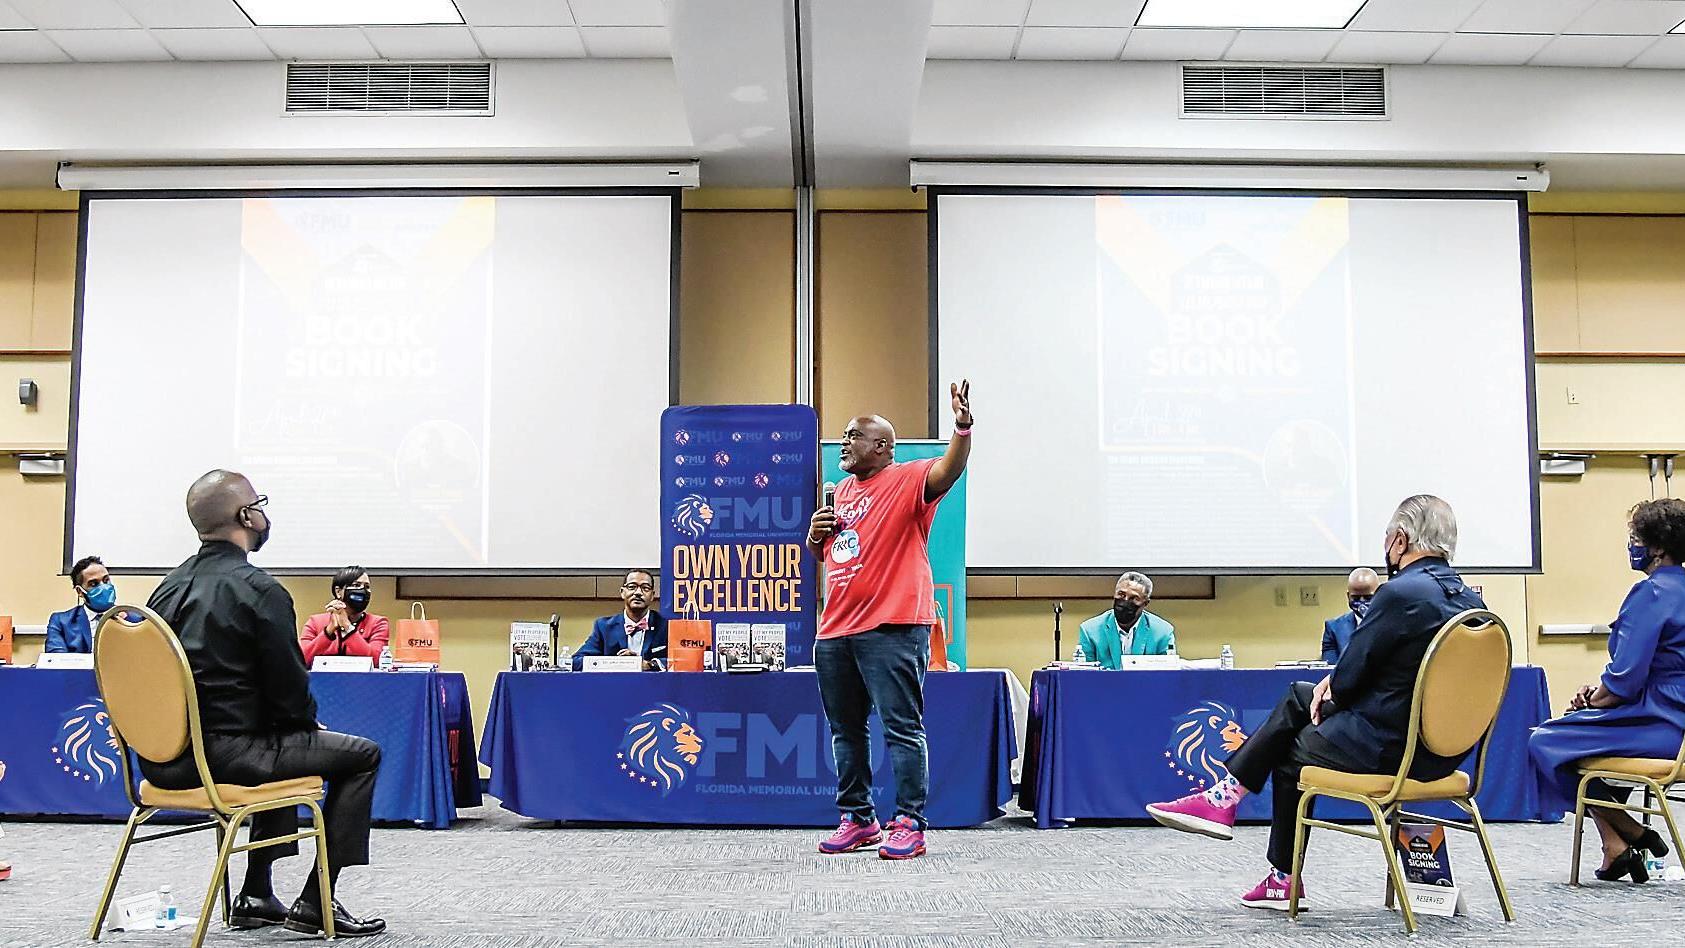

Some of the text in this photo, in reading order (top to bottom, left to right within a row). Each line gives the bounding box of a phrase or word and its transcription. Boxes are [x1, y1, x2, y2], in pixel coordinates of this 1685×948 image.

[306, 315, 423, 346] BOOK
[1168, 314, 1283, 345] BOOK
[286, 346, 439, 377] SIGNING
[1148, 346, 1300, 376] SIGNING
[709, 496, 802, 530] FMU
[673, 544, 801, 579] OWN YOUR
[673, 579, 802, 612] EXCELLENCE
[415, 639, 433, 647] FMU
[687, 639, 705, 648] FMU
[695, 783, 746, 793] FLORIDA
[749, 785, 811, 796] MEMORIAL
[1408, 859, 1440, 869] SIGNING
[1410, 851, 1435, 861] BOOK
[1415, 894, 1445, 905] RESERVED
